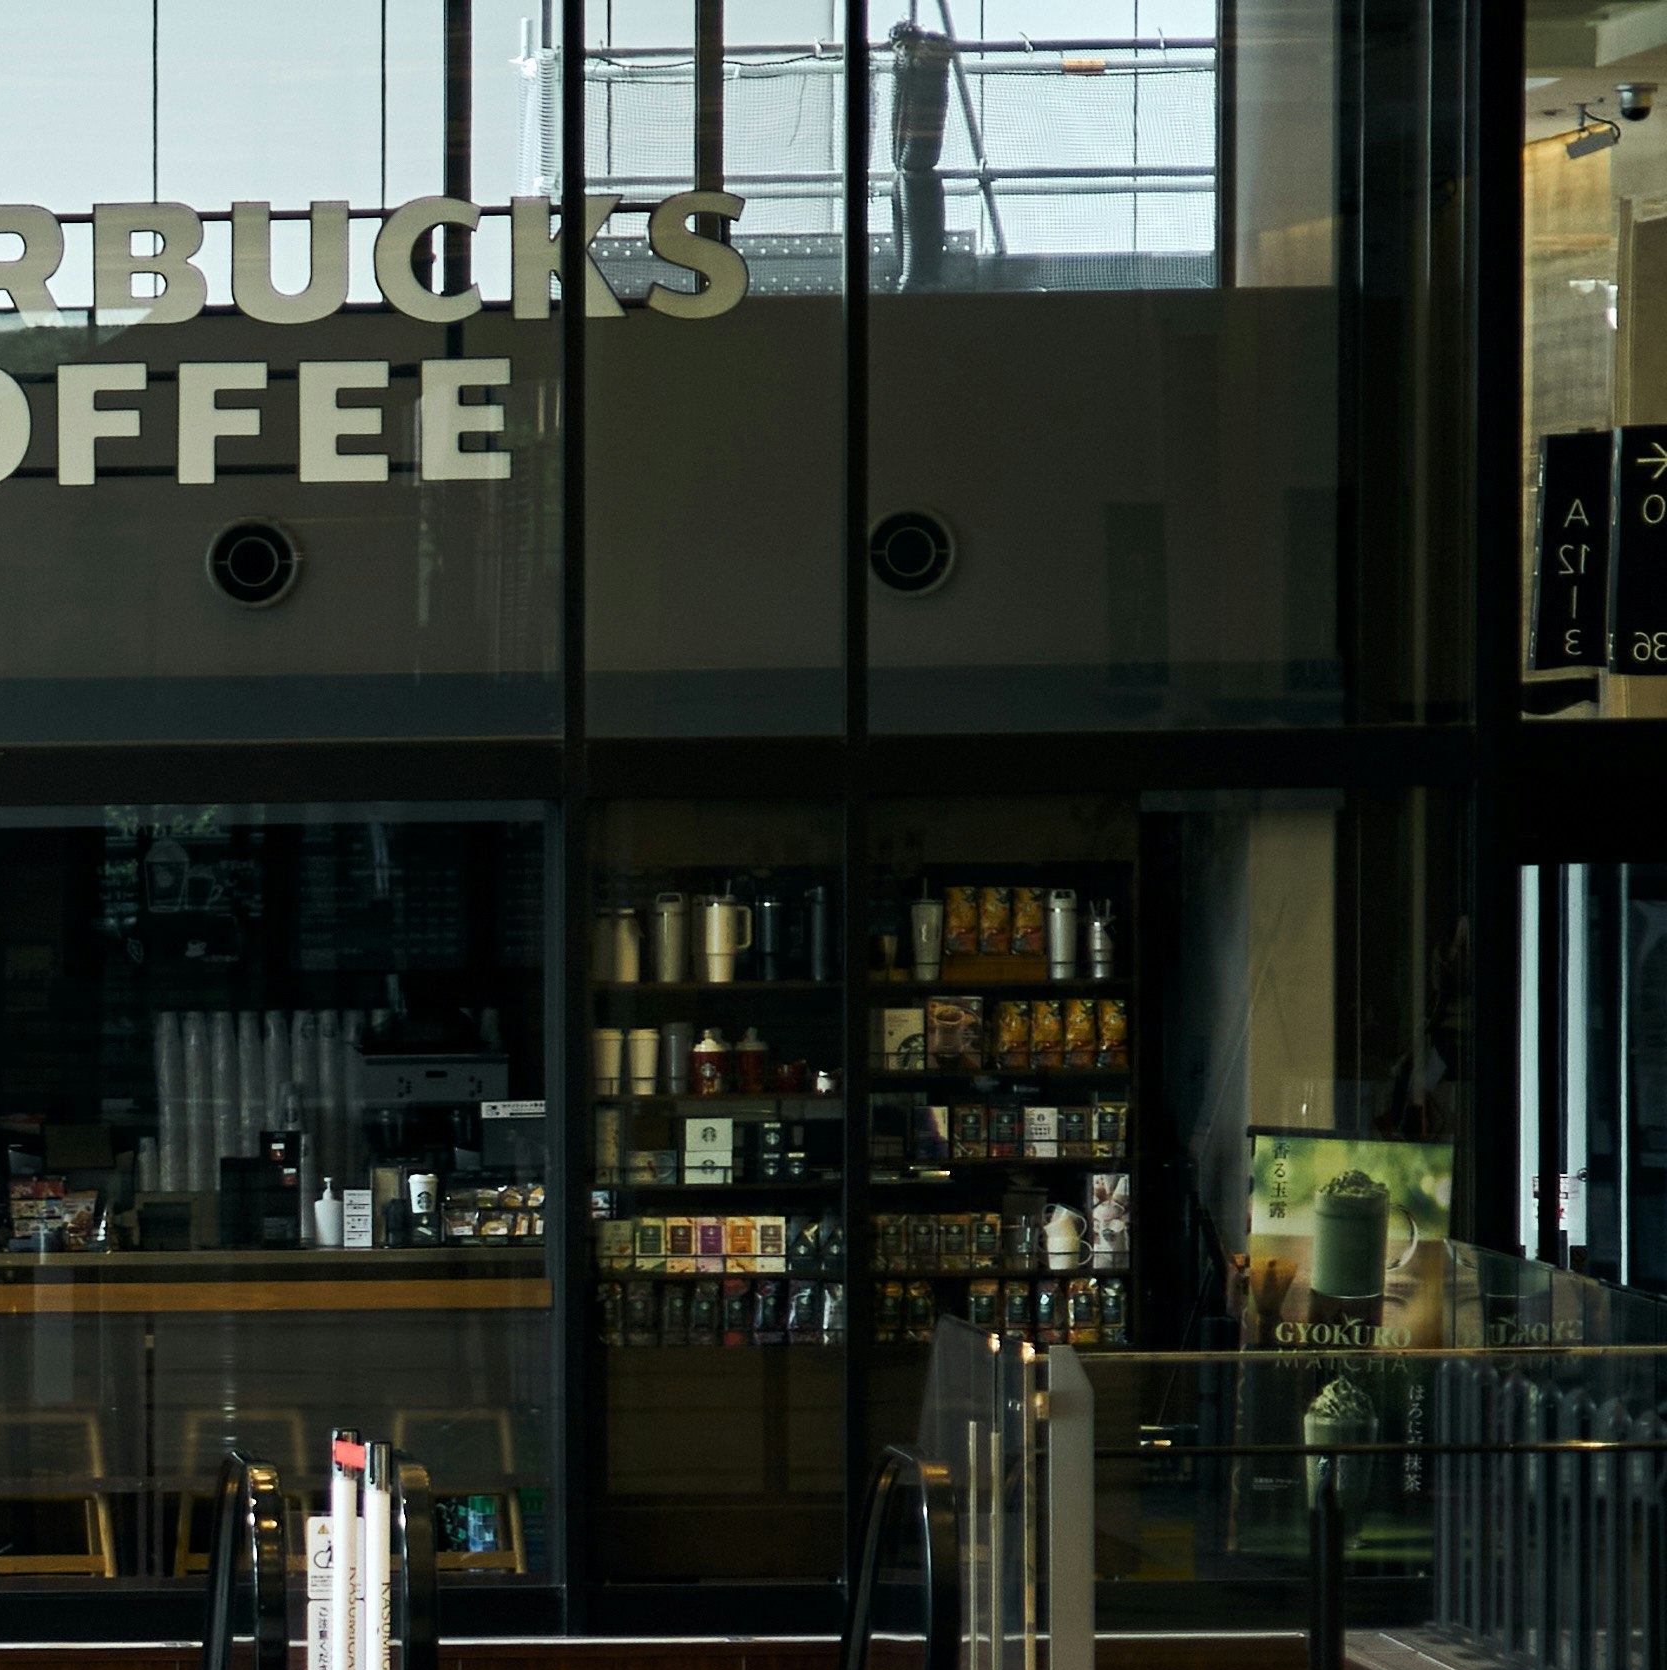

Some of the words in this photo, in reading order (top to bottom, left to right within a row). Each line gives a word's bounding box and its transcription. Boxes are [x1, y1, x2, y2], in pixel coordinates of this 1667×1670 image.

[1268, 1141, 1291, 1220] 香る玉露
[1275, 1315, 1413, 1349] GYOKURO
